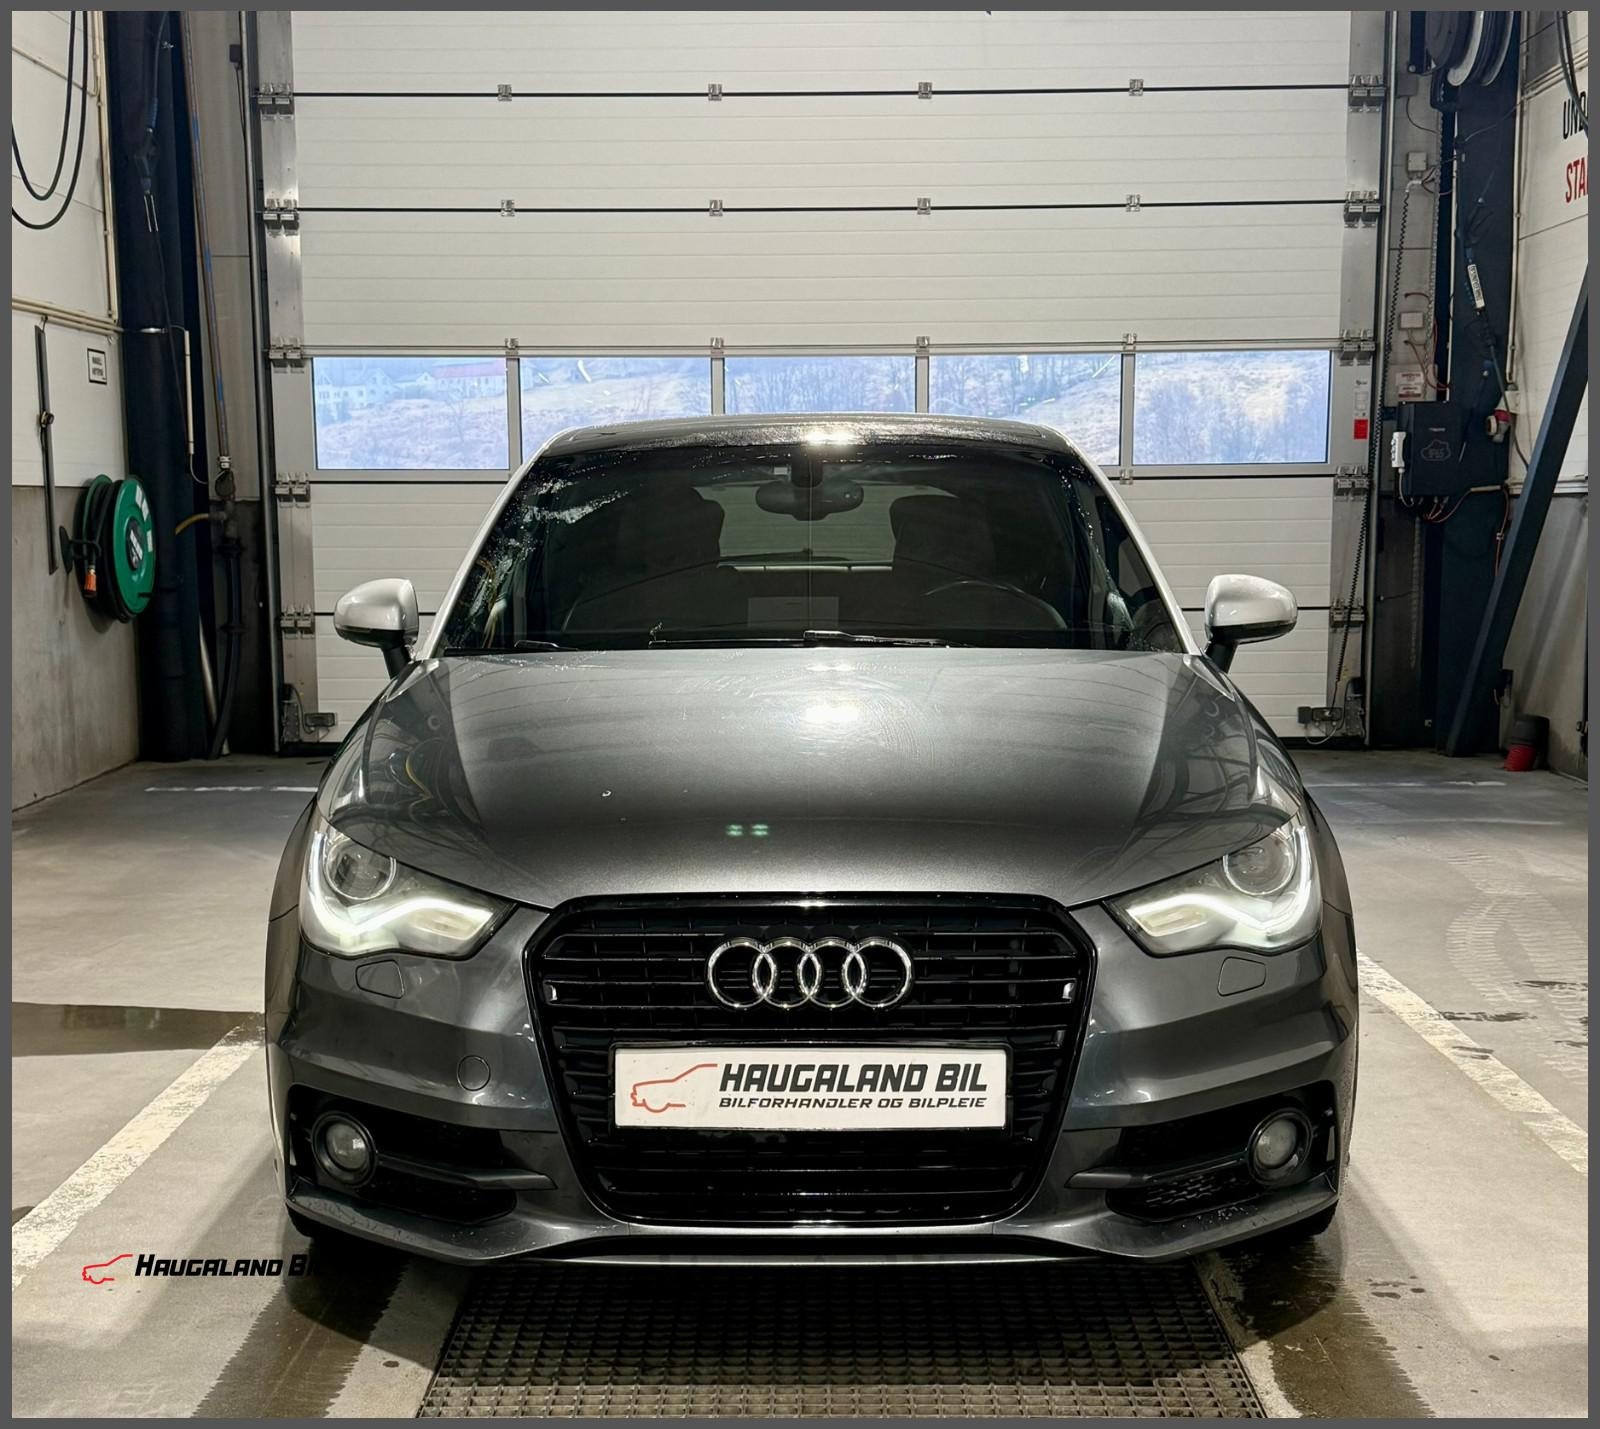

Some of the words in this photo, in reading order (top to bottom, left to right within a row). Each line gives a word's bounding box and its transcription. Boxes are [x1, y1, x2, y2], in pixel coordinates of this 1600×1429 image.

[1562, 91, 1588, 140] UND
[1565, 156, 1588, 203] STA
[718, 1062, 929, 1093] HAUGALAND
[934, 1063, 988, 1093] BIL
[718, 1096, 872, 1109] BILFORHANDLER
[876, 1097, 903, 1109] OG
[908, 1097, 988, 1109] BILPLEIE
